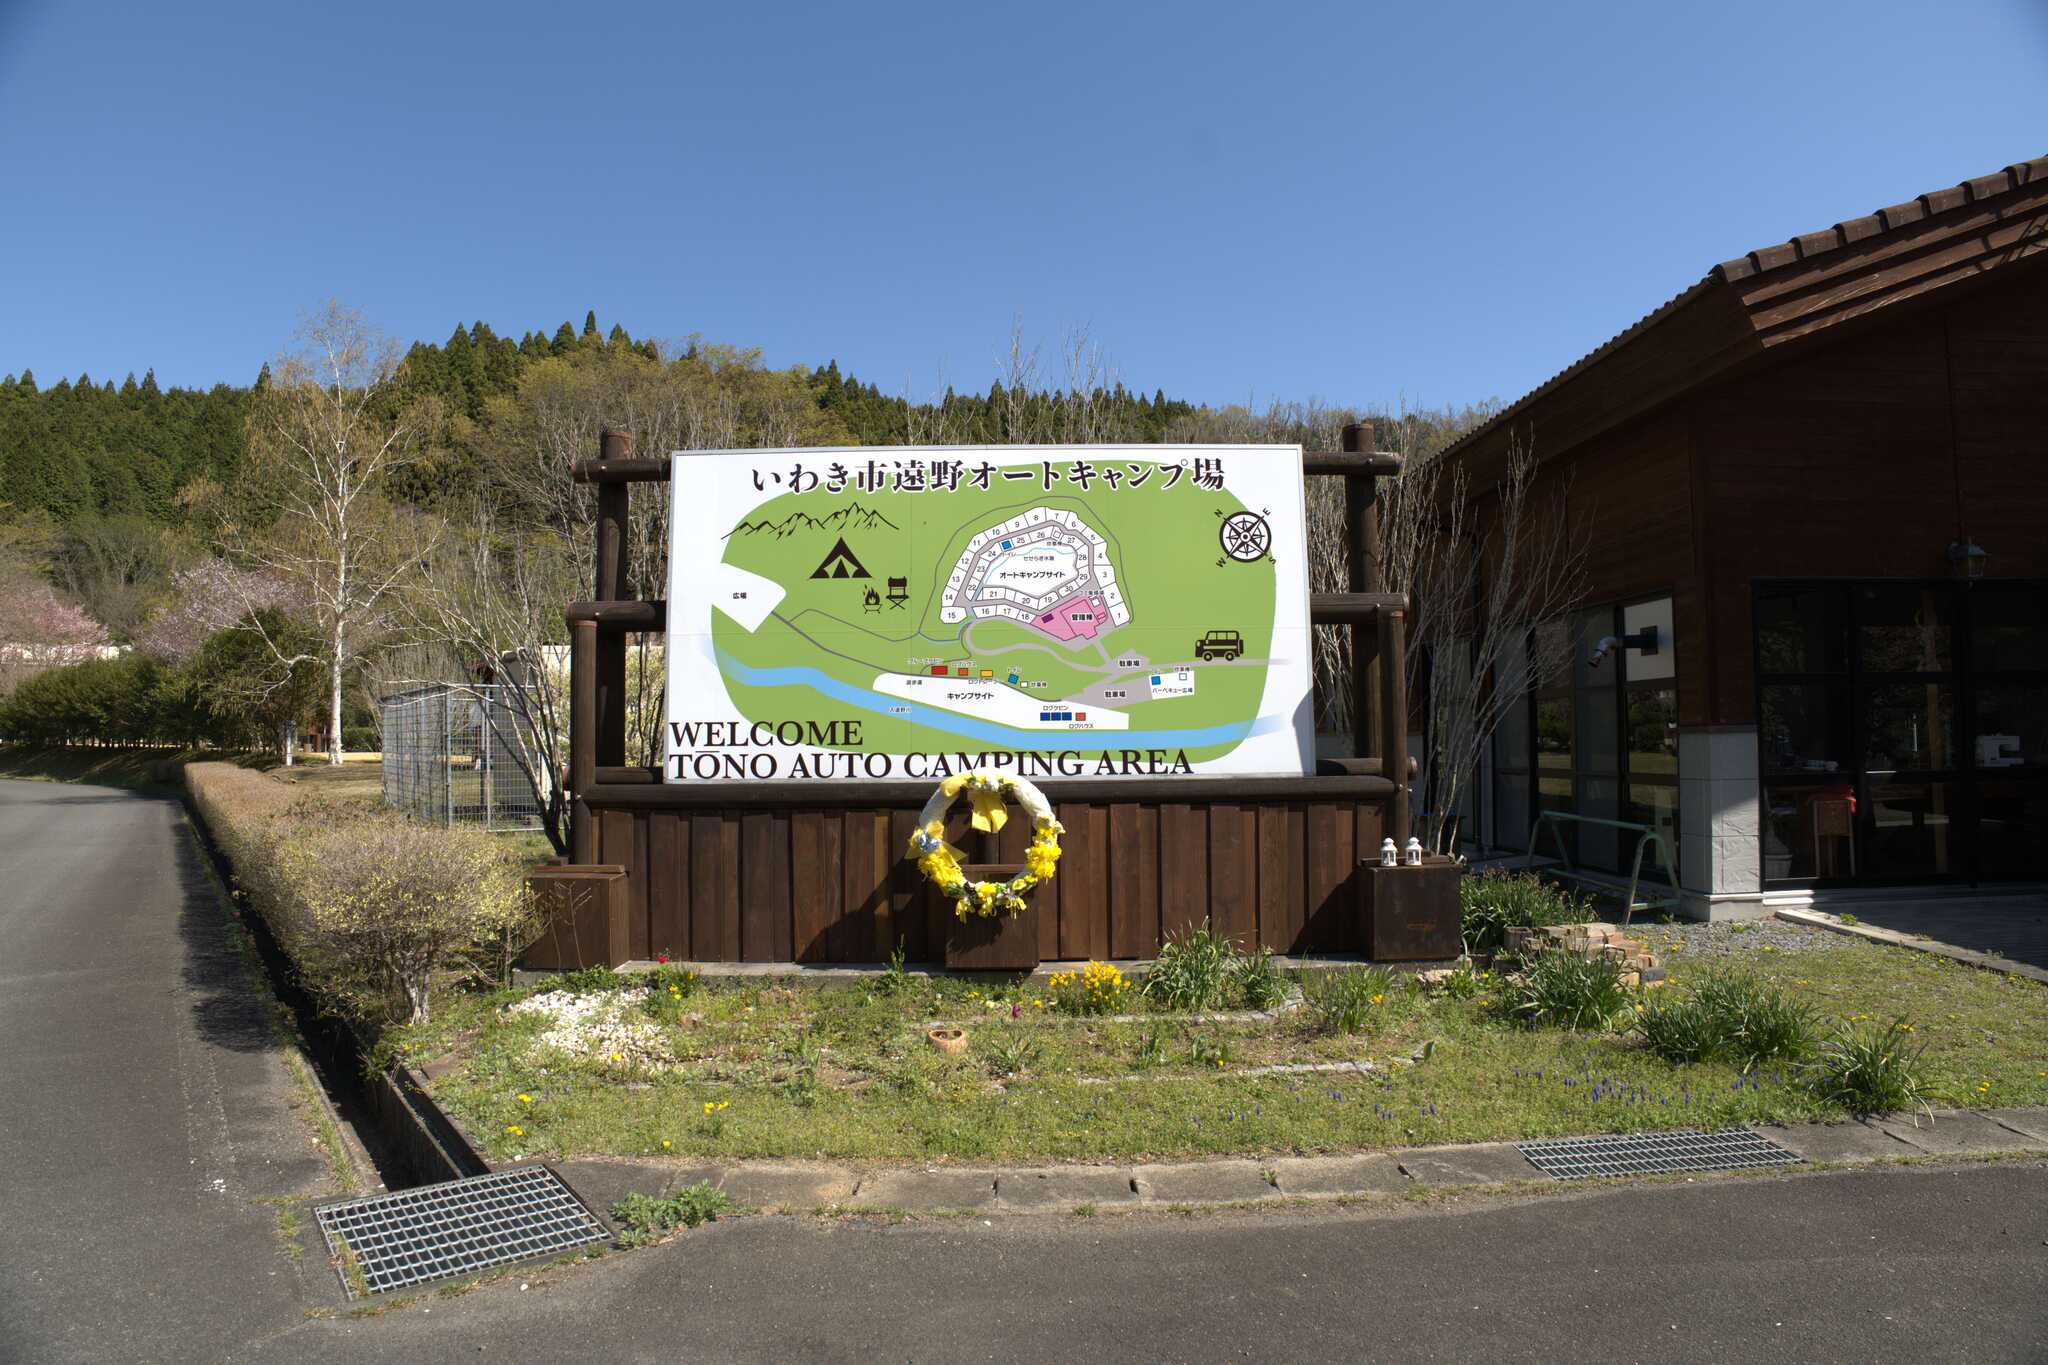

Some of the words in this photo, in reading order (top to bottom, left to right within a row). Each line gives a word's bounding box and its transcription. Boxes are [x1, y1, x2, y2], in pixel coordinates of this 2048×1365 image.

[752, 458, 1225, 493] いわき市遠野オートキャンプ場
[992, 528, 1001, 536] 10
[1000, 571, 1066, 580] オートキャンプサイト
[1079, 573, 1089, 581] 29
[1065, 585, 1075, 593] 30
[989, 590, 998, 598] 21
[947, 691, 995, 701] キャンプサイト
[670, 720, 864, 747] WELCOME
[669, 751, 778, 779] TŌNO
[788, 752, 893, 779] AUTO
[904, 752, 1084, 778] CAMPING
[1094, 749, 1195, 776] AREA
